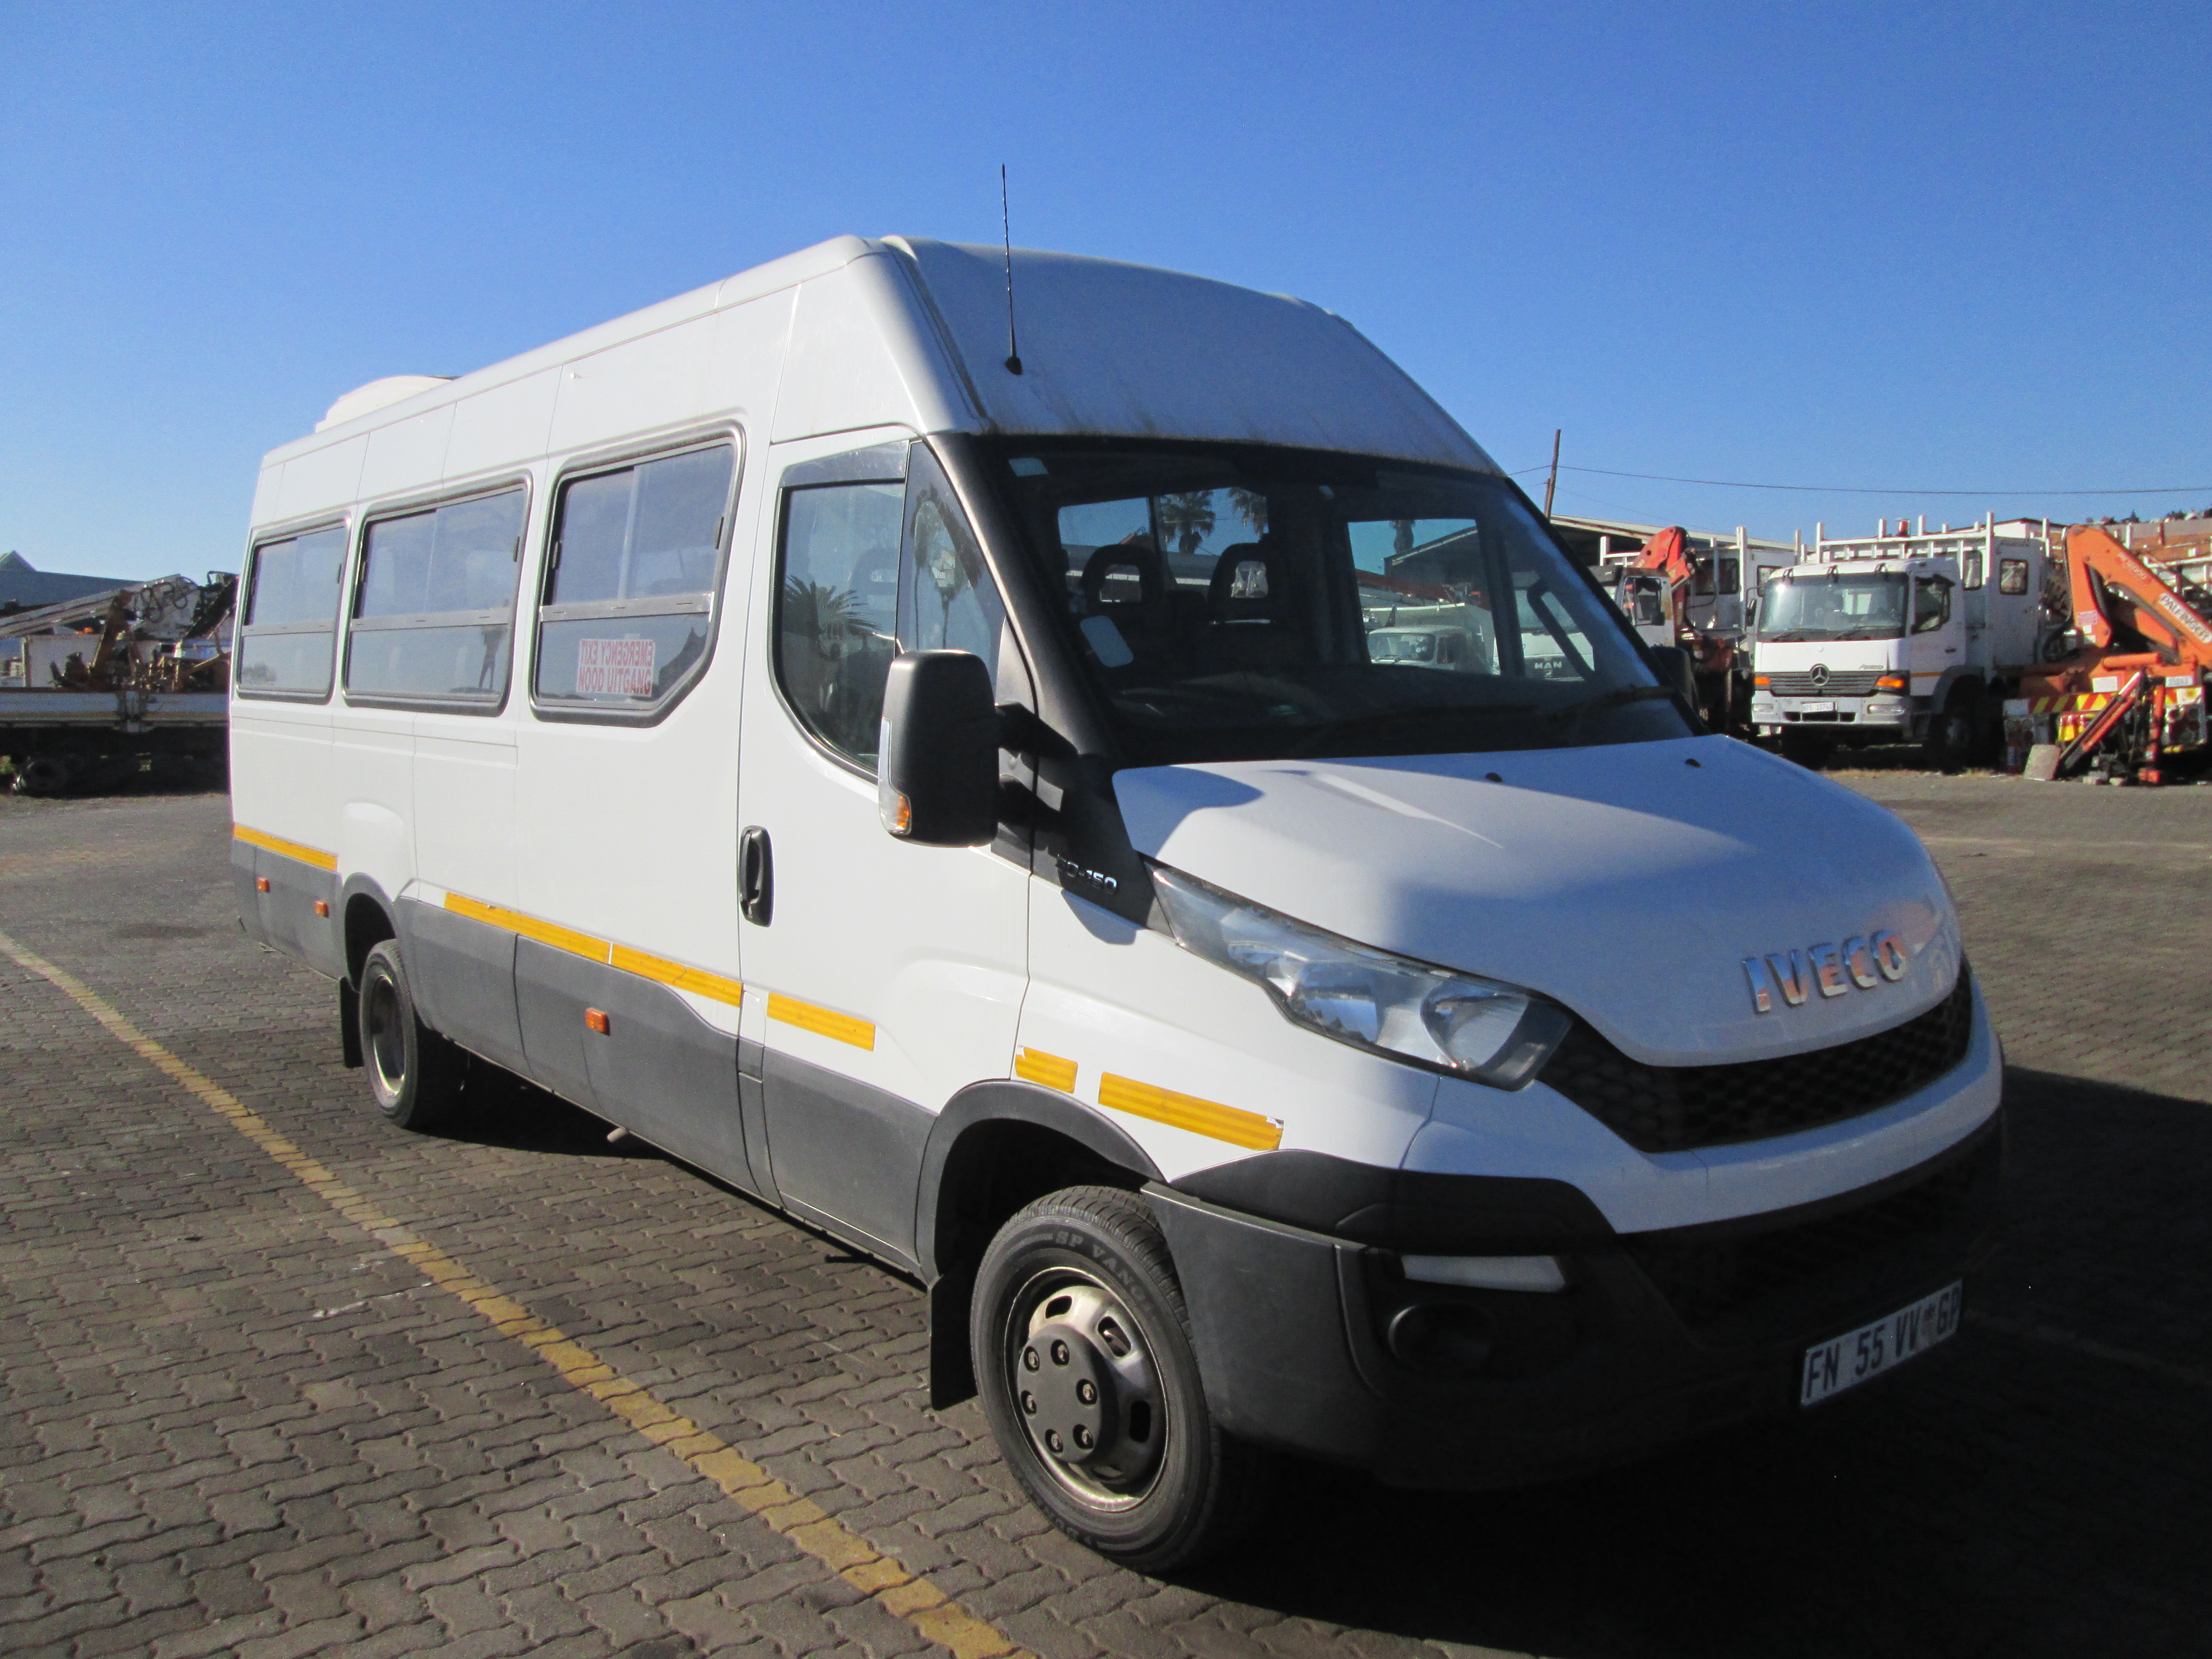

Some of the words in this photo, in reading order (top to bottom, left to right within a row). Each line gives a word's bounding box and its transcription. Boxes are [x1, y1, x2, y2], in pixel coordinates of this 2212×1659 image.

[1534, 661, 1562, 669] MAN
[578, 667, 603, 692] NOOD
[607, 668, 652, 695] UITGANG
[1743, 930, 1907, 1014] IVECO
[1056, 1230, 1084, 1247] SP
[1806, 1343, 1840, 1398] FN
[1855, 1324, 1886, 1377] 55
[1896, 1306, 1922, 1358] VV
[1937, 1286, 1960, 1335] GP
